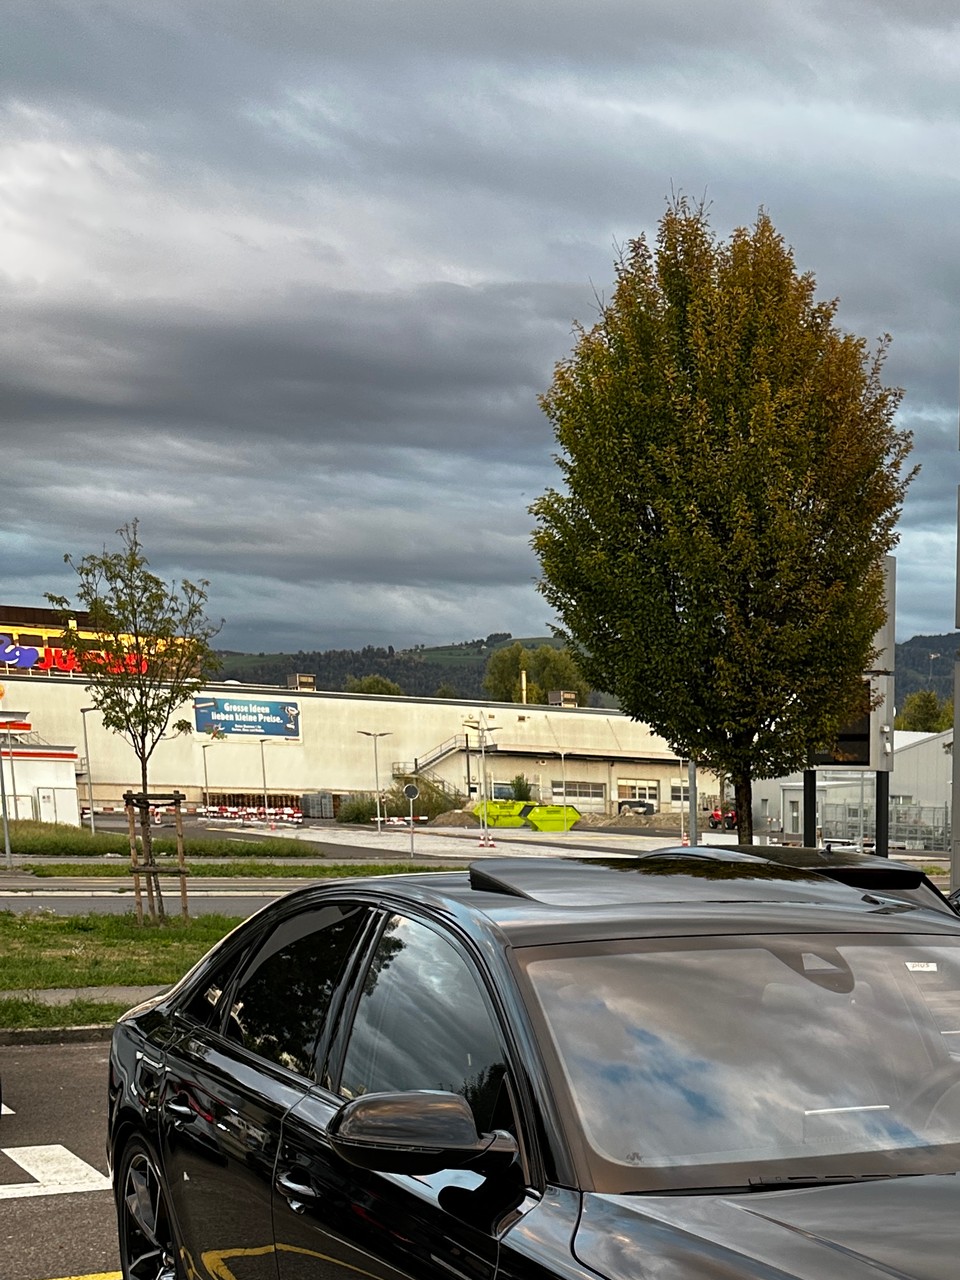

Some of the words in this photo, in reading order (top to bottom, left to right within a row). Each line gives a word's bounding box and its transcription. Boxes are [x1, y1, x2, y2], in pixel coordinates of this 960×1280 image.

[223, 702, 248, 713] Grosse
[249, 704, 270, 714] Ideen
[211, 712, 234, 721] lieben
[234, 713, 257, 723] kleine
[257, 713, 283, 724] Preise.
